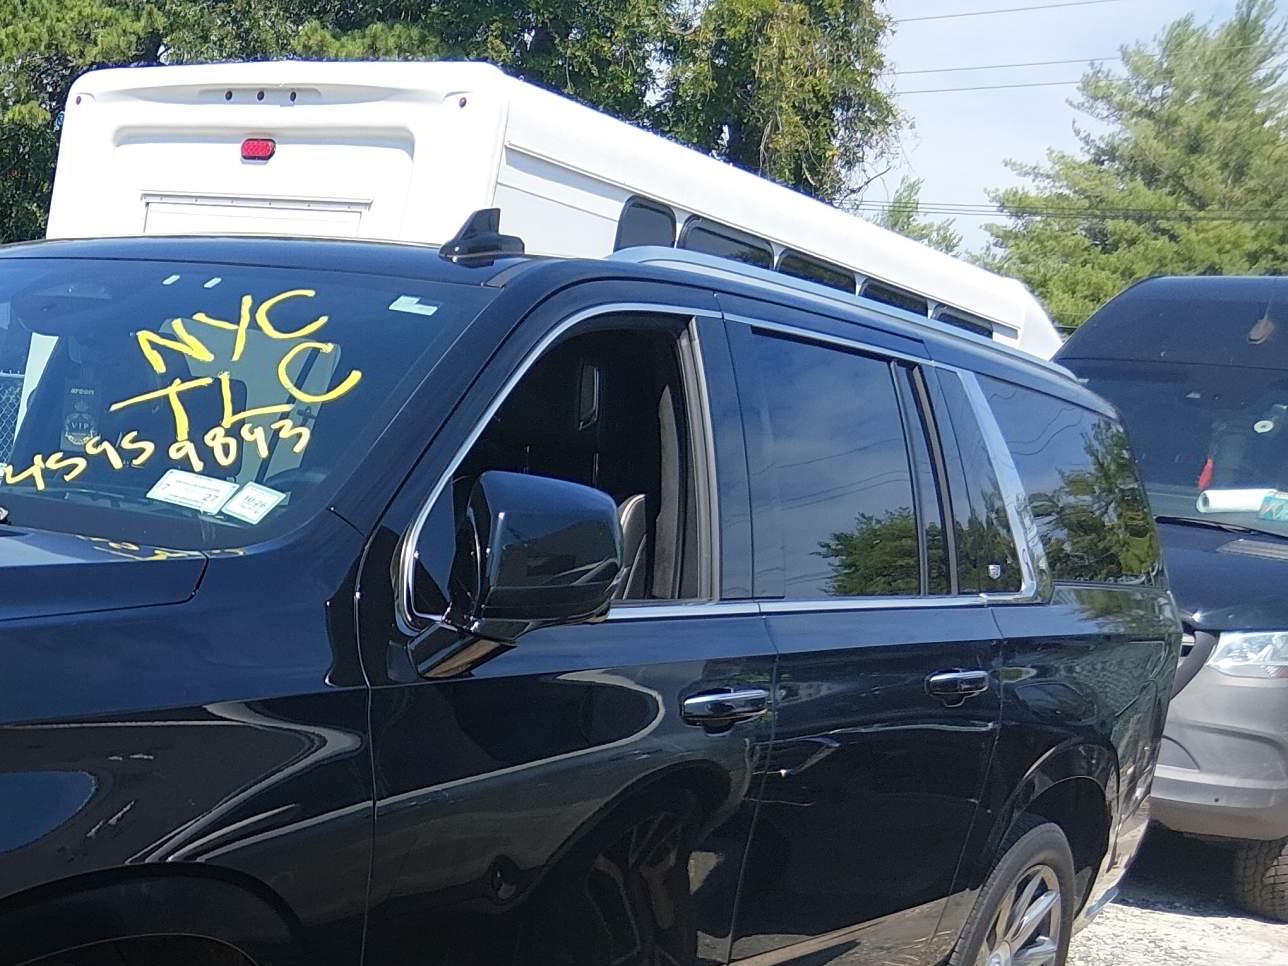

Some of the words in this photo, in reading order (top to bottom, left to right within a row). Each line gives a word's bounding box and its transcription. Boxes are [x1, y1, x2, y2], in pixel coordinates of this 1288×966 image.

[136, 289, 329, 374] NYC
[71, 422, 90, 431] VIP
[109, 341, 363, 442] TLC
